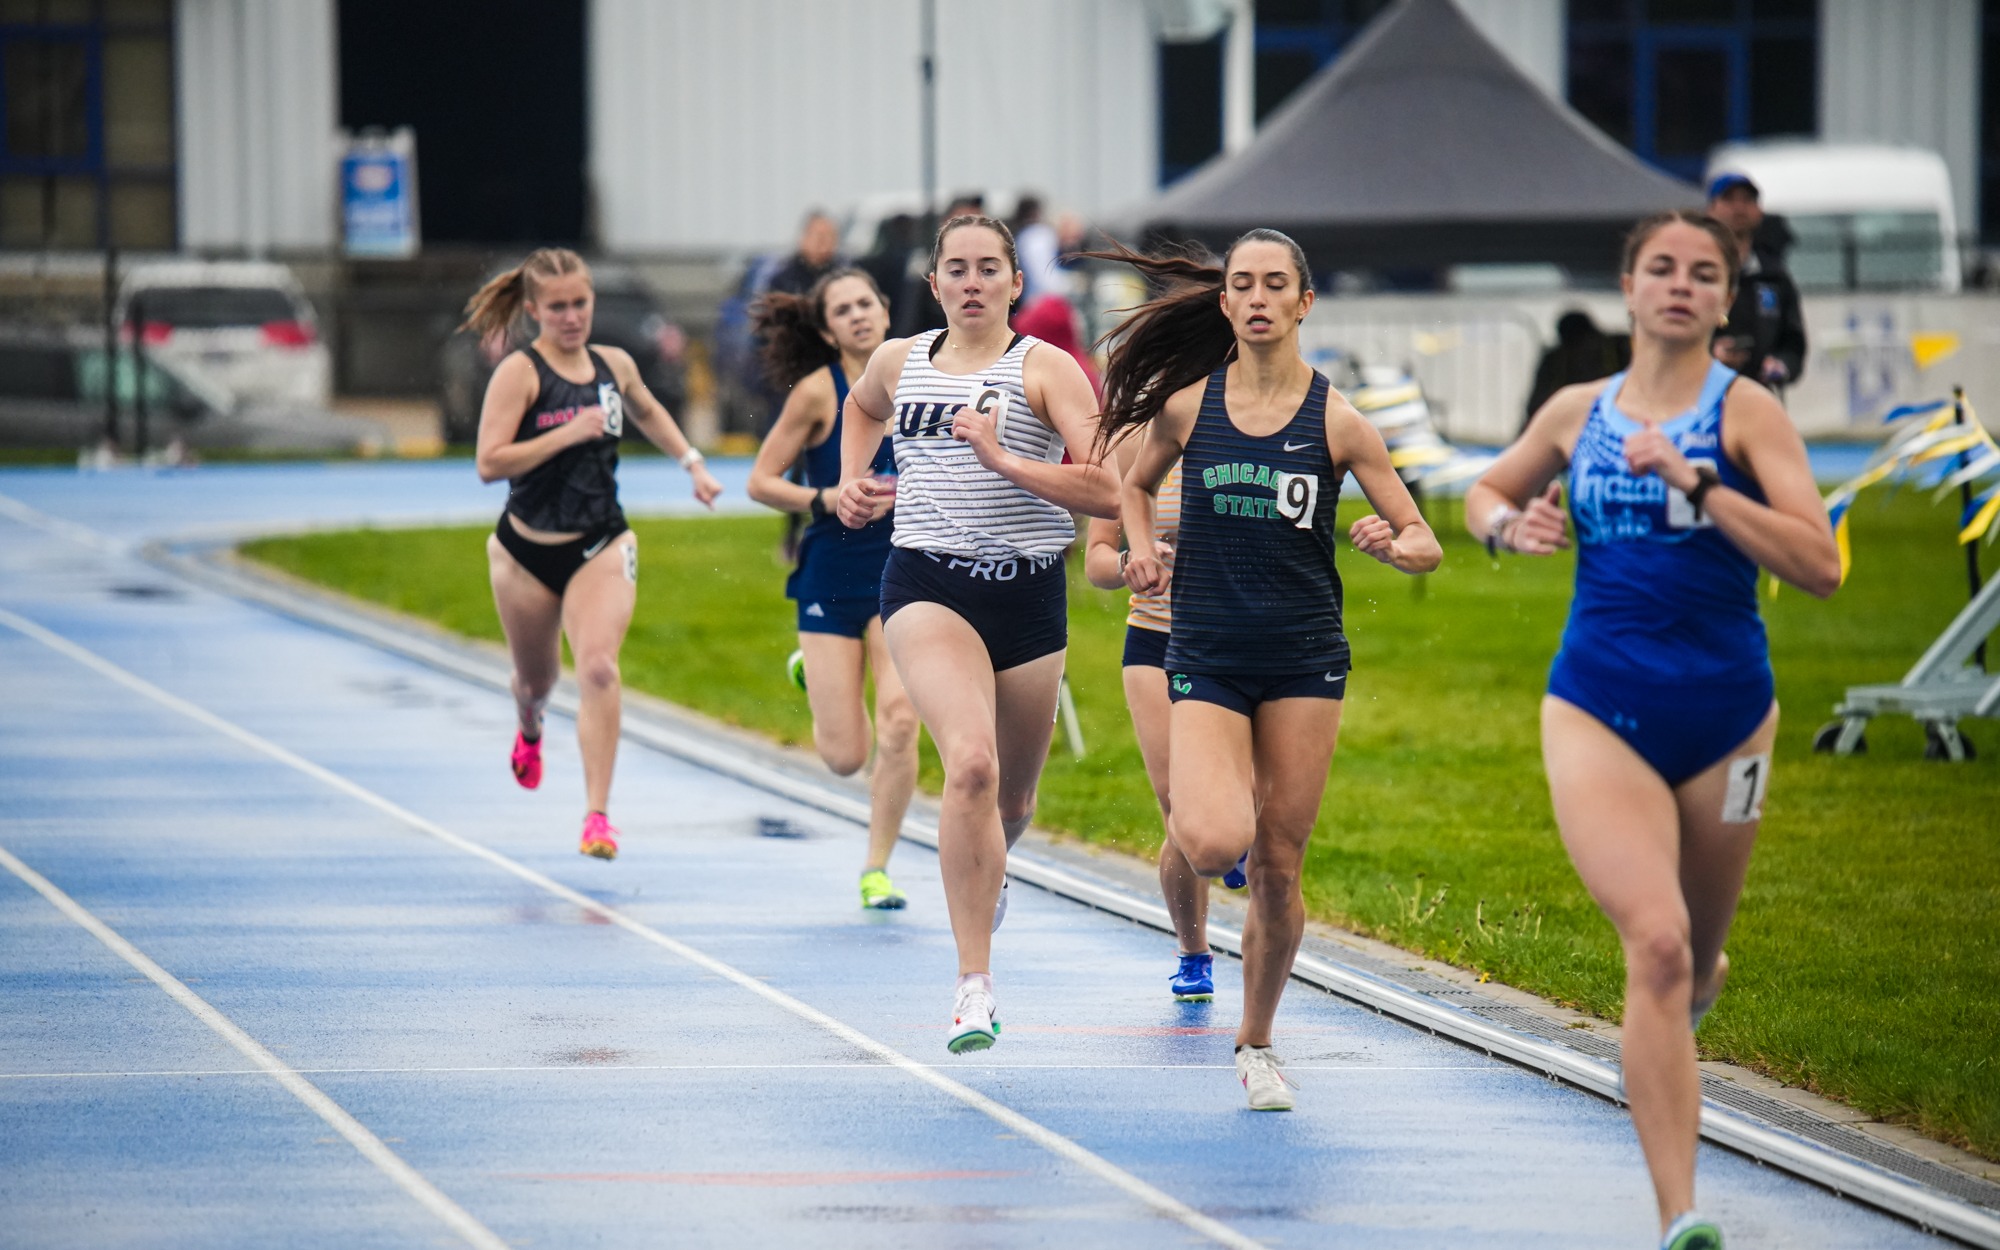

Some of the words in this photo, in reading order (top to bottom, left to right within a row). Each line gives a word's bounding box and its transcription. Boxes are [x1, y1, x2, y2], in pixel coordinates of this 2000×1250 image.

[1213, 493, 1282, 519] STATE
[1286, 476, 1310, 525] 9
[947, 557, 1018, 581] PRO
[1742, 761, 1760, 817] 1
